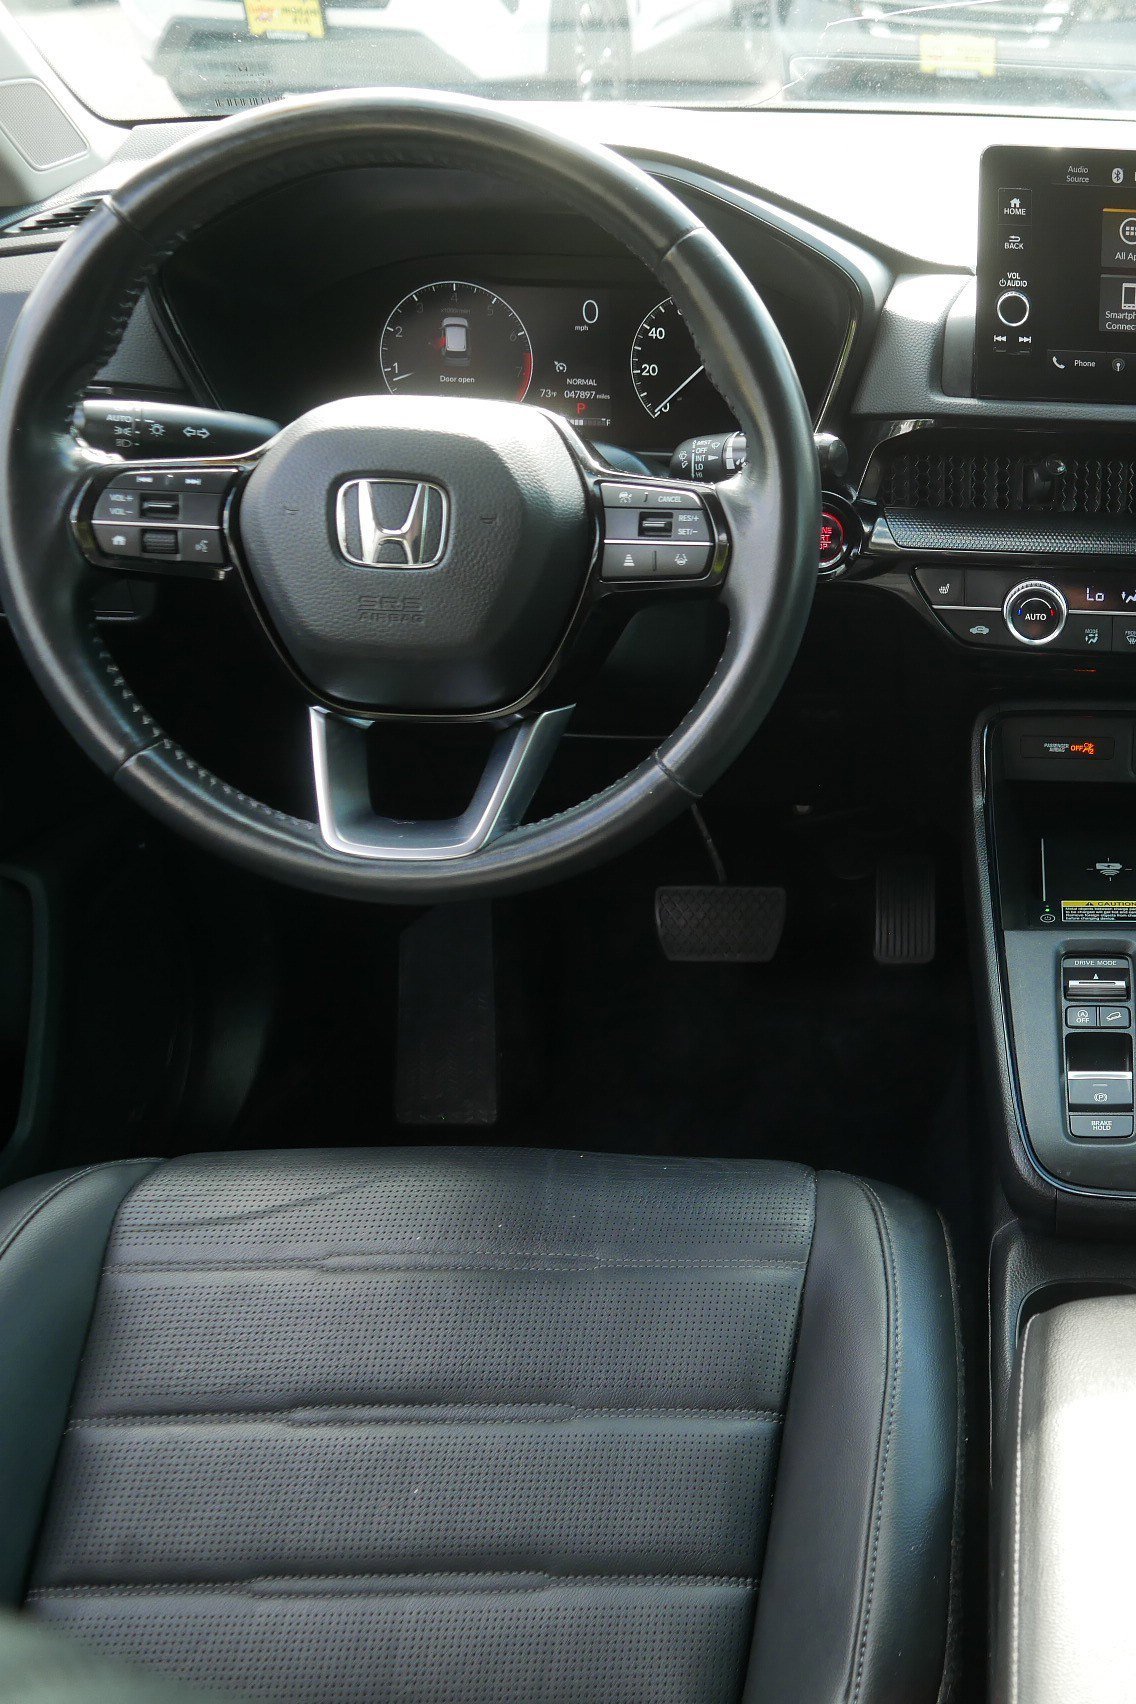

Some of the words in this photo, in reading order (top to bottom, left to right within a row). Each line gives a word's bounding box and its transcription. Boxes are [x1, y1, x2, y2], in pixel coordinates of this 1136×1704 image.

[1068, 166, 1088, 174] Audio
[1066, 175, 1090, 183] Source
[1004, 207, 1026, 216] HOME
[1114, 252, 1126, 260] All
[1006, 280, 1028, 288] AUDIO
[582, 300, 598, 324] 0
[395, 326, 403, 338] 2
[648, 328, 666, 340] 40
[393, 362, 398, 374] 1
[1074, 360, 1096, 368] Phone
[641, 364, 658, 376] 20
[458, 376, 475, 384] open
[564, 391, 596, 399] 047897
[578, 403, 587, 414] P
[106, 414, 132, 422] AUTO
[1086, 587, 1104, 602] Lo
[1024, 613, 1047, 621] AUTO
